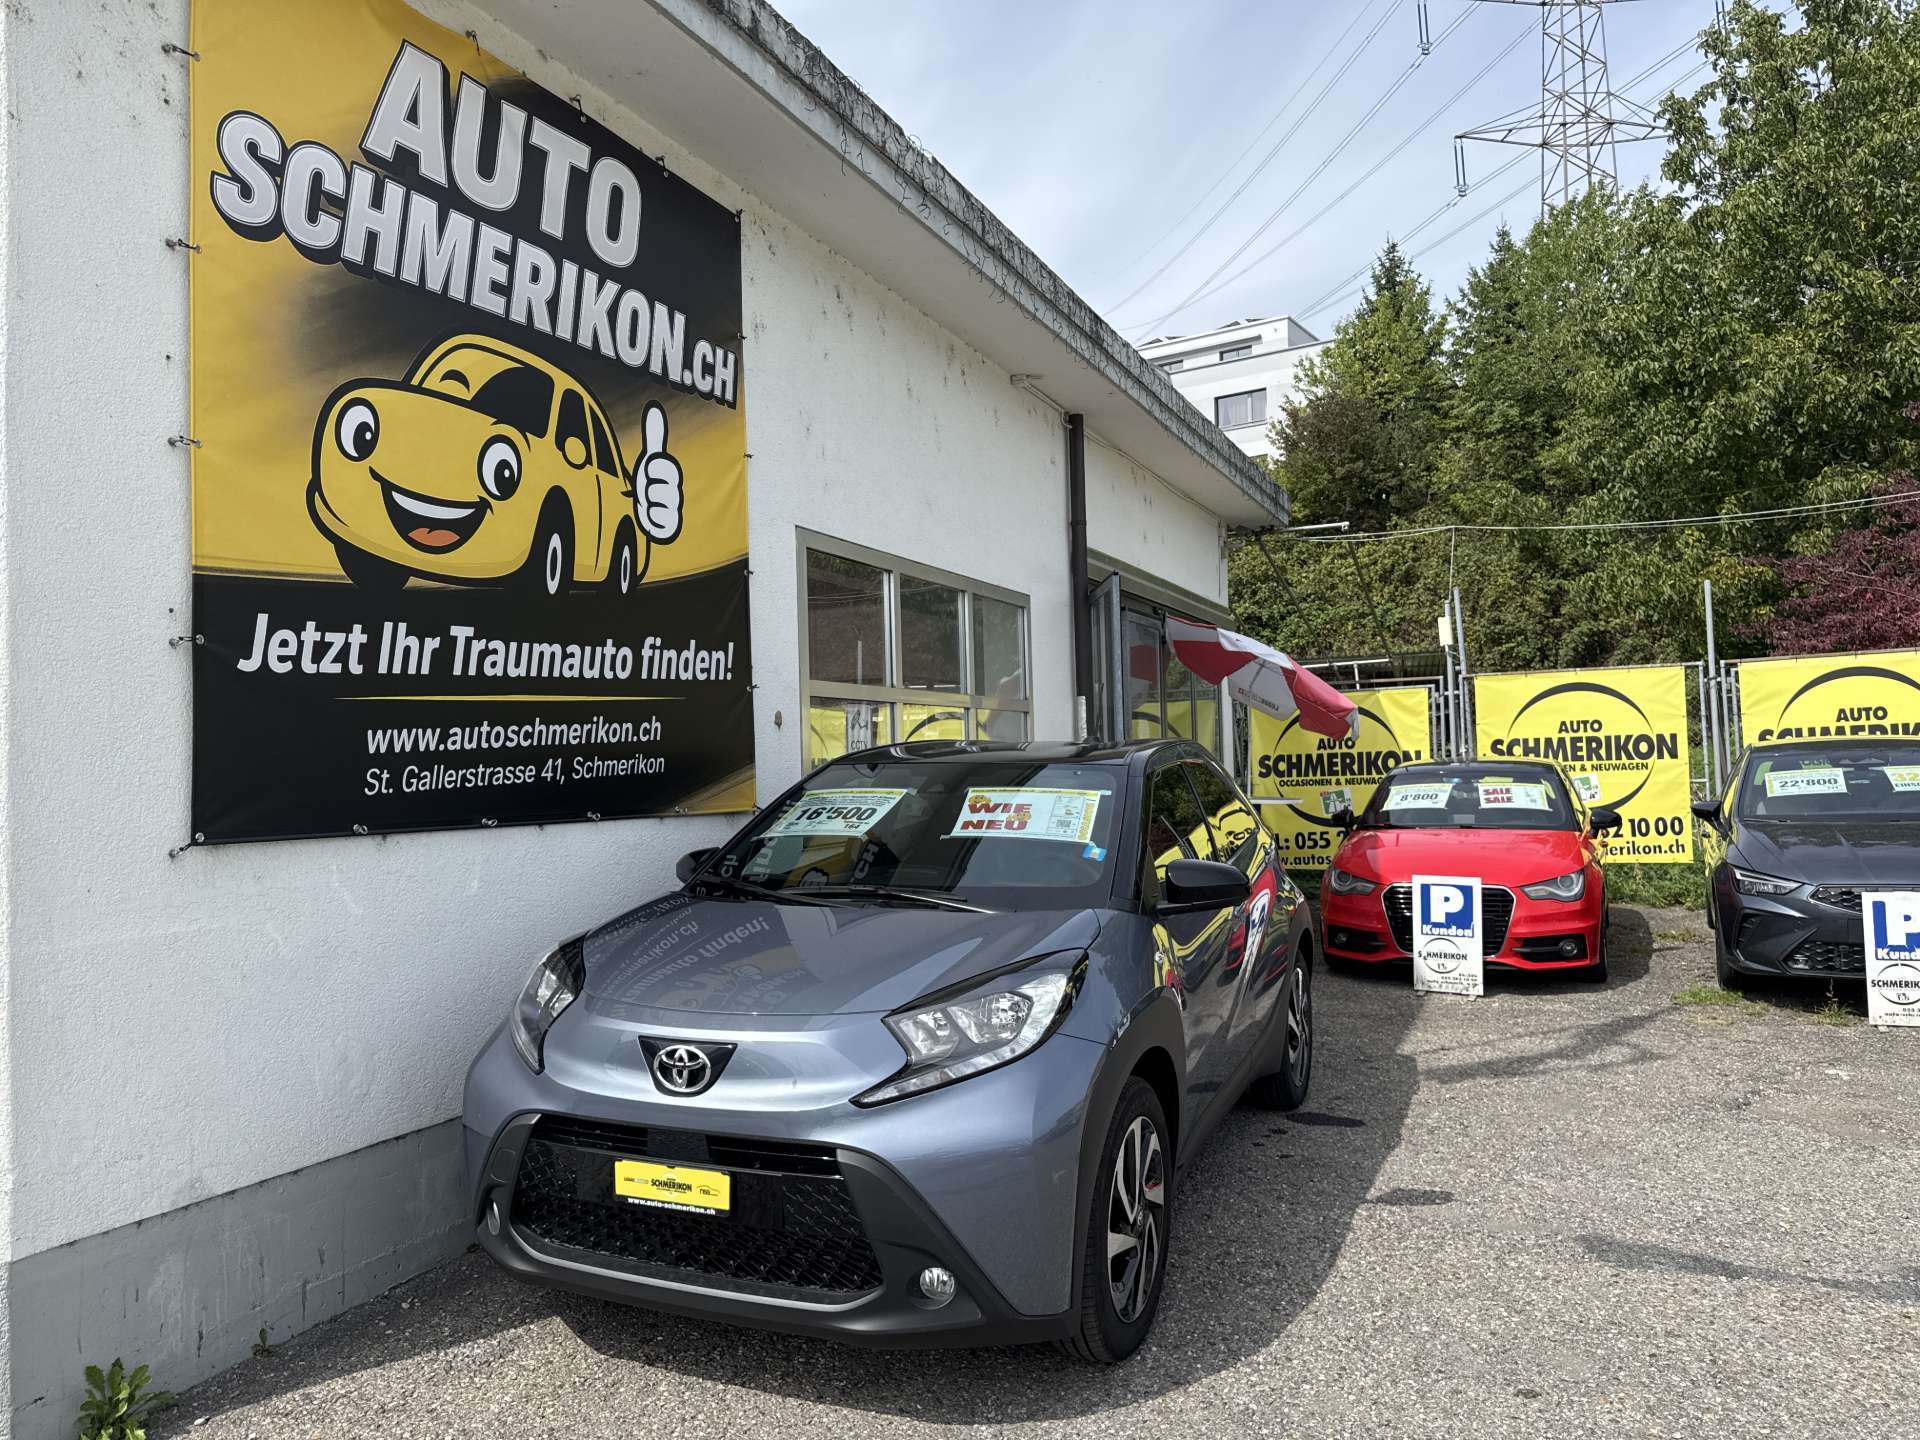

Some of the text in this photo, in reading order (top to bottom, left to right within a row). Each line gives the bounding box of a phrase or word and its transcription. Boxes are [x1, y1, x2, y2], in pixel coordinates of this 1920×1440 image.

[361, 40, 643, 269] AUTO
[212, 111, 738, 403] SCHMERIKON.CH
[237, 613, 734, 681] Jetzt Ihr Traumauto finden!
[1836, 706, 1888, 723] AUTO
[367, 716, 662, 754] www.autoschmerikon.ch
[1558, 719, 1602, 734] AUTO
[1490, 733, 1679, 762] SCHMERIKON
[364, 754, 666, 796] St. Gallerstrasse 41, Schmerikon
[1579, 764, 1588, 772] &
[1591, 762, 1649, 771] NEUWAGEN
[1278, 778, 1332, 788] OCCASIONEN
[1335, 777, 1342, 786] &
[1778, 777, 1838, 789] 22'800
[1483, 787, 1513, 796] SALE
[1484, 795, 1515, 804] SALE
[794, 806, 878, 821] 16'500
[967, 803, 1033, 815] WIE
[960, 819, 1030, 831] NEU
[1629, 818, 1650, 838] 10
[1654, 816, 1685, 837] 00
[1295, 831, 1331, 850] 055
[1430, 885, 1464, 923] P
[651, 1178, 692, 1192] SCHMERIKON
[627, 1197, 716, 1215] www.auto-schmerikon.ch
